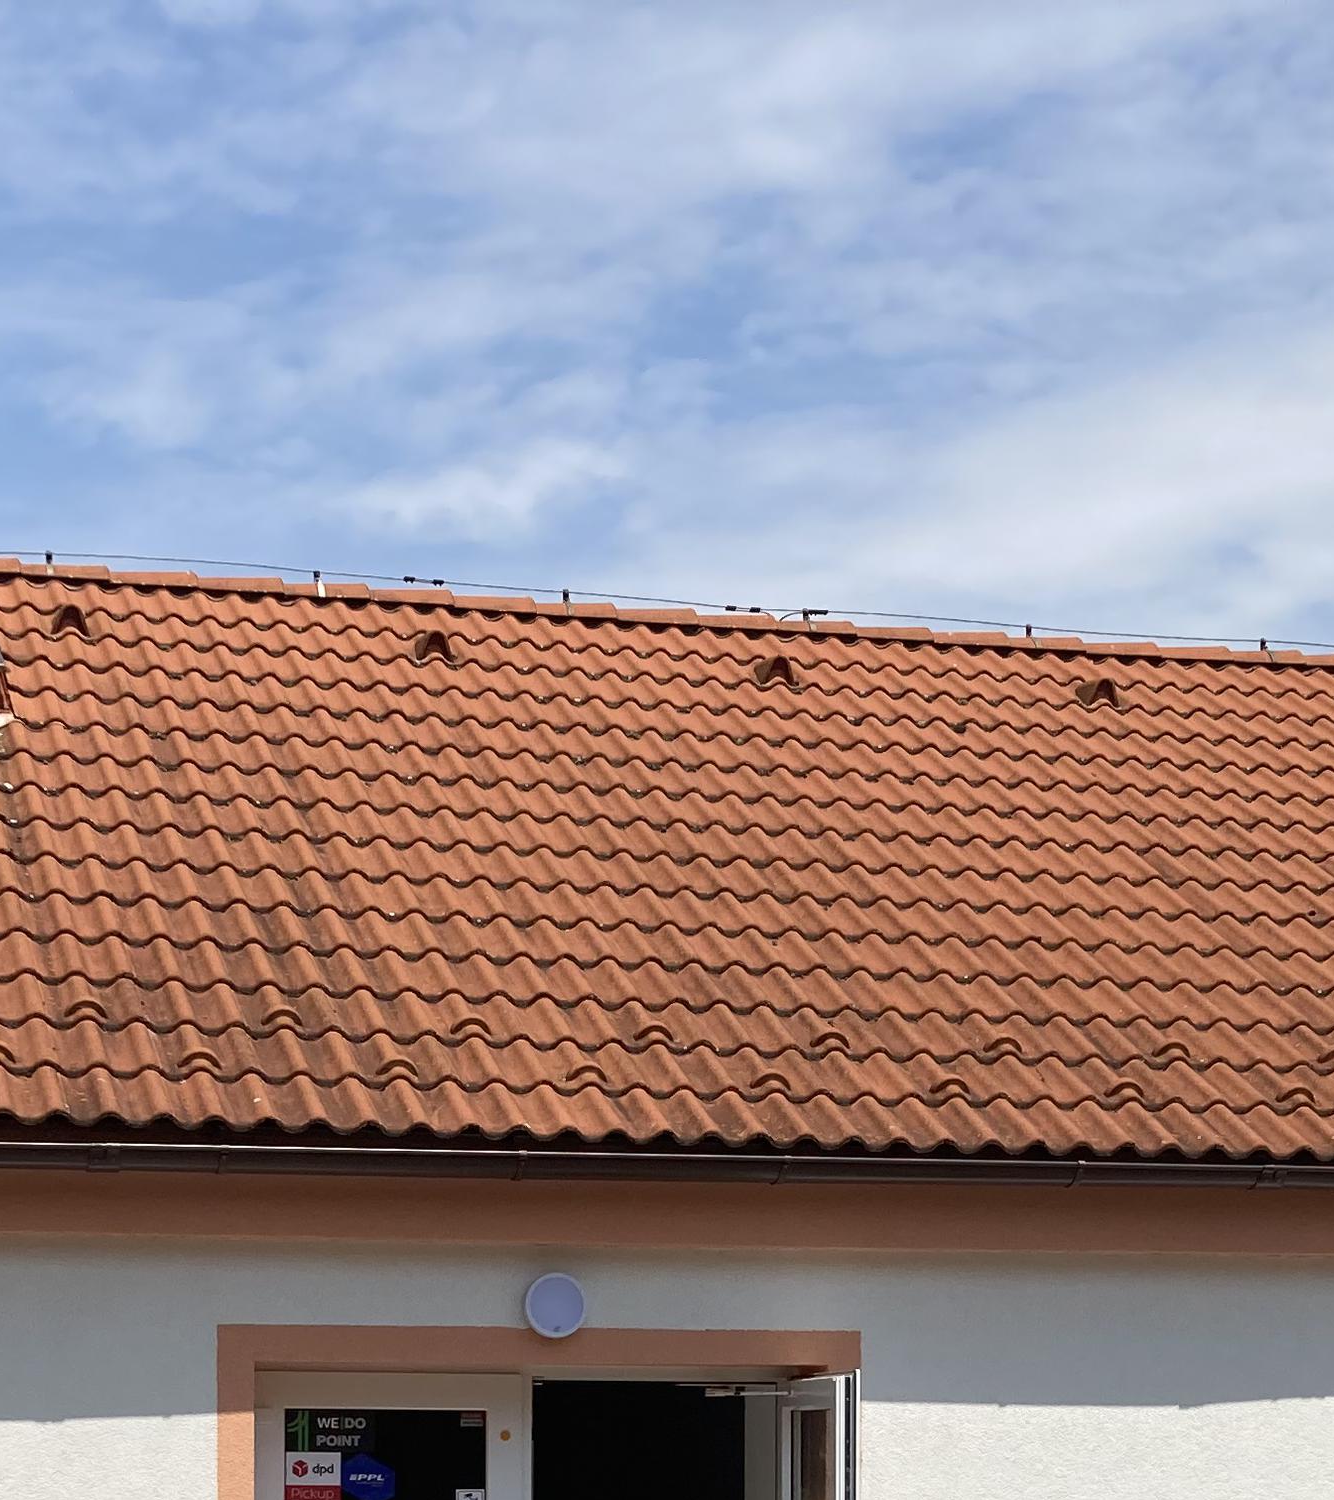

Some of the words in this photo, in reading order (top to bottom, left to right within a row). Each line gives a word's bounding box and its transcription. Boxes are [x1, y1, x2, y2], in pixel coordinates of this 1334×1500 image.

[316, 1435, 361, 1447] POINT
[312, 1463, 335, 1477] dpd
[357, 1473, 385, 1481] PPL
[291, 1487, 335, 1500] Pickup
